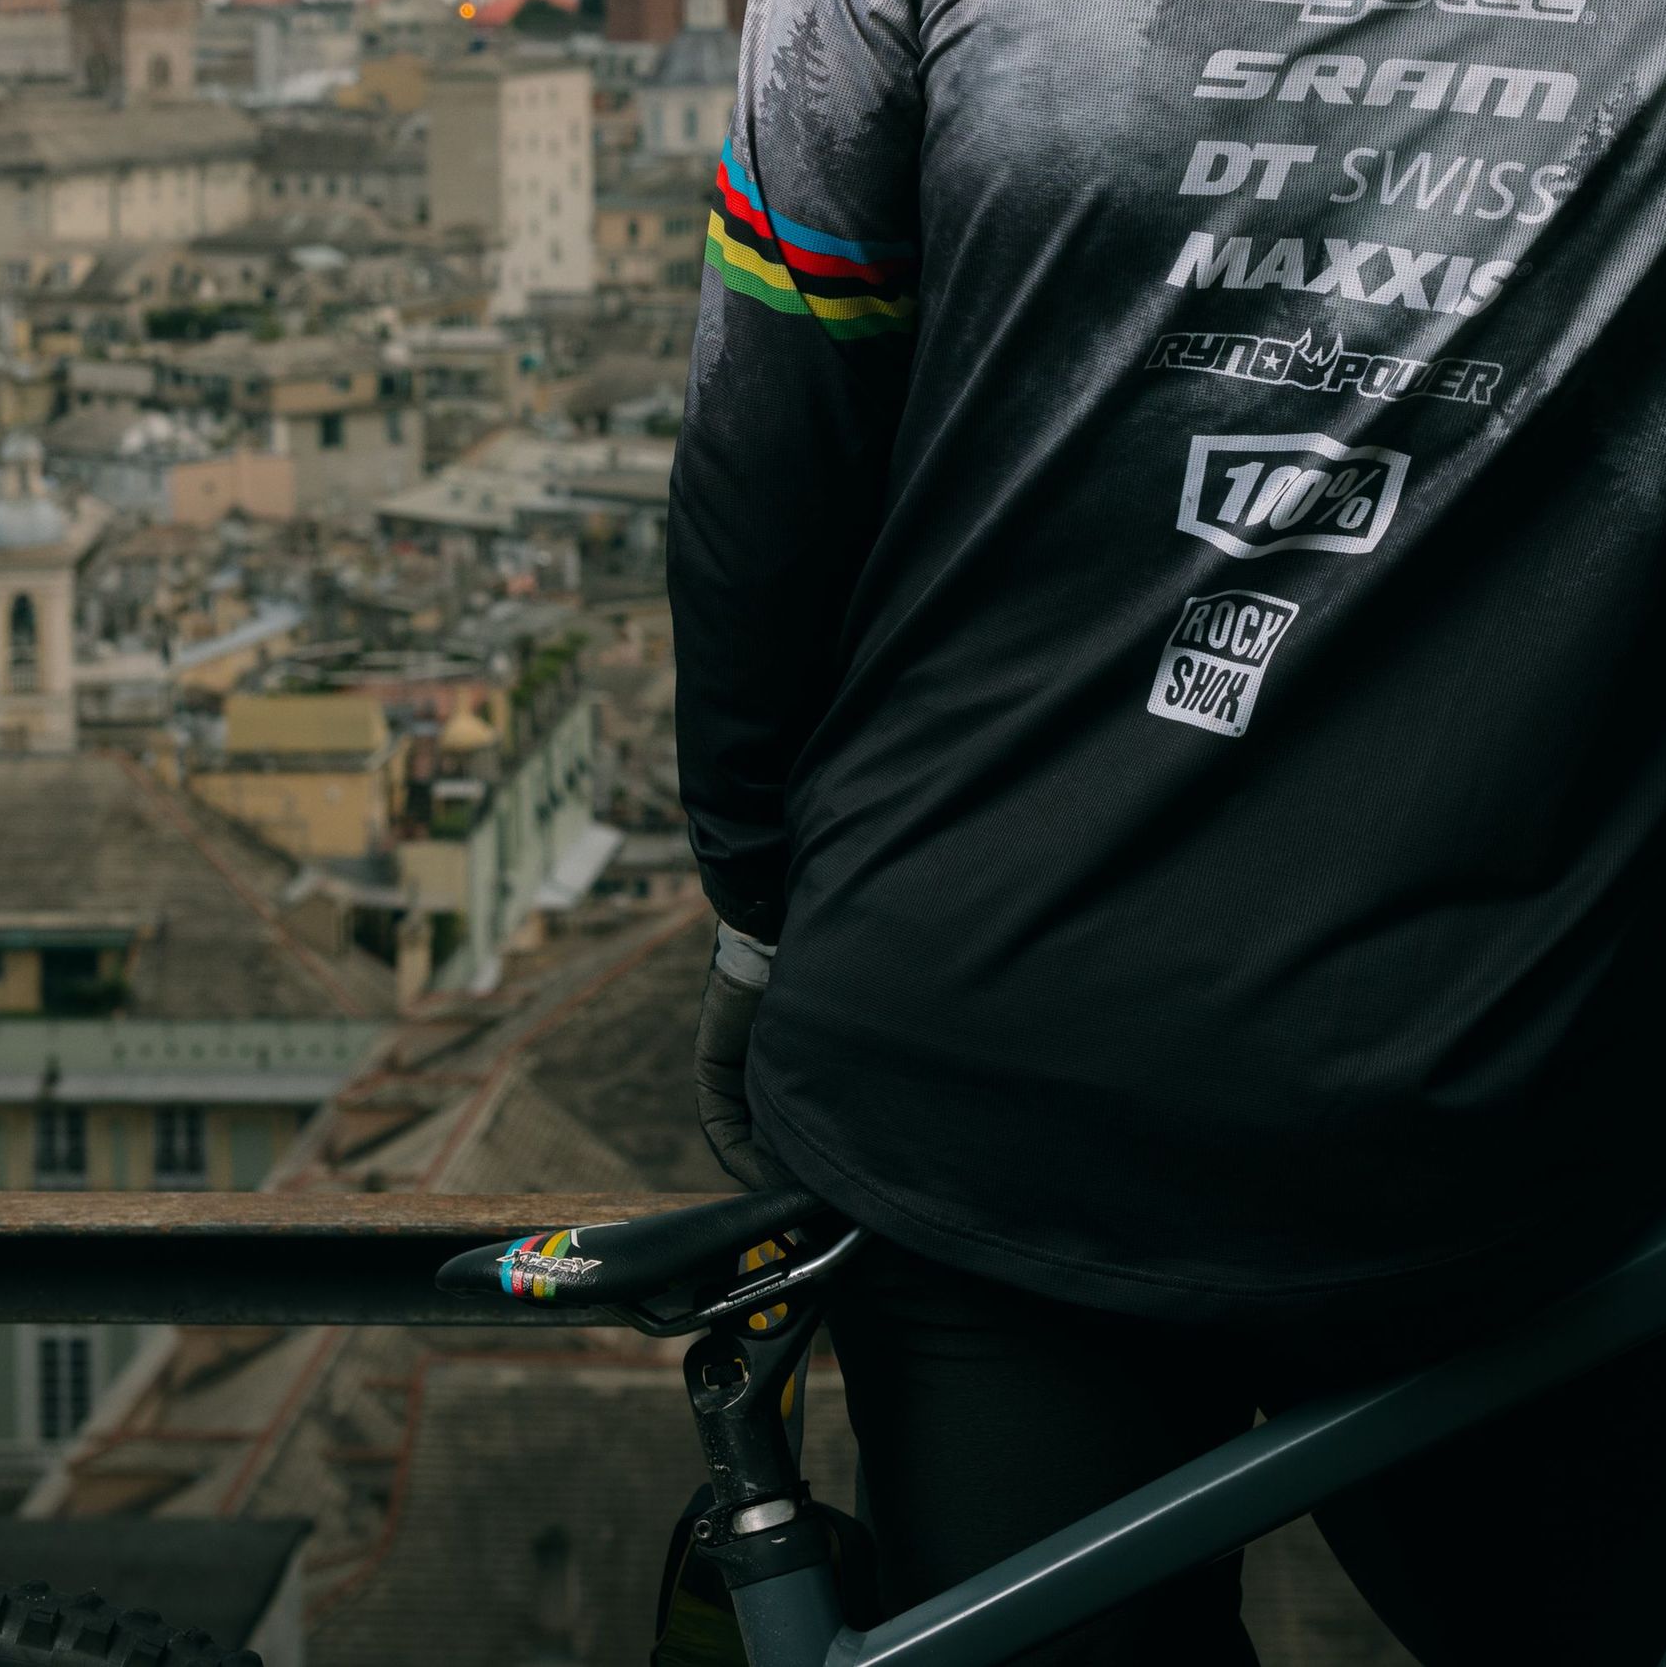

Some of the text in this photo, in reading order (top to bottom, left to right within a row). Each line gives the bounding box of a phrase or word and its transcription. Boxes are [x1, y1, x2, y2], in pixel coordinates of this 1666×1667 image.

[1193, 49, 1579, 123] SRAM
[1178, 140, 1571, 225] DT SWISS
[1165, 231, 1519, 317] MAXXIS
[1216, 460, 1382, 531] 100%
[1182, 599, 1285, 661] ROCK
[1164, 655, 1250, 724] SHOX
